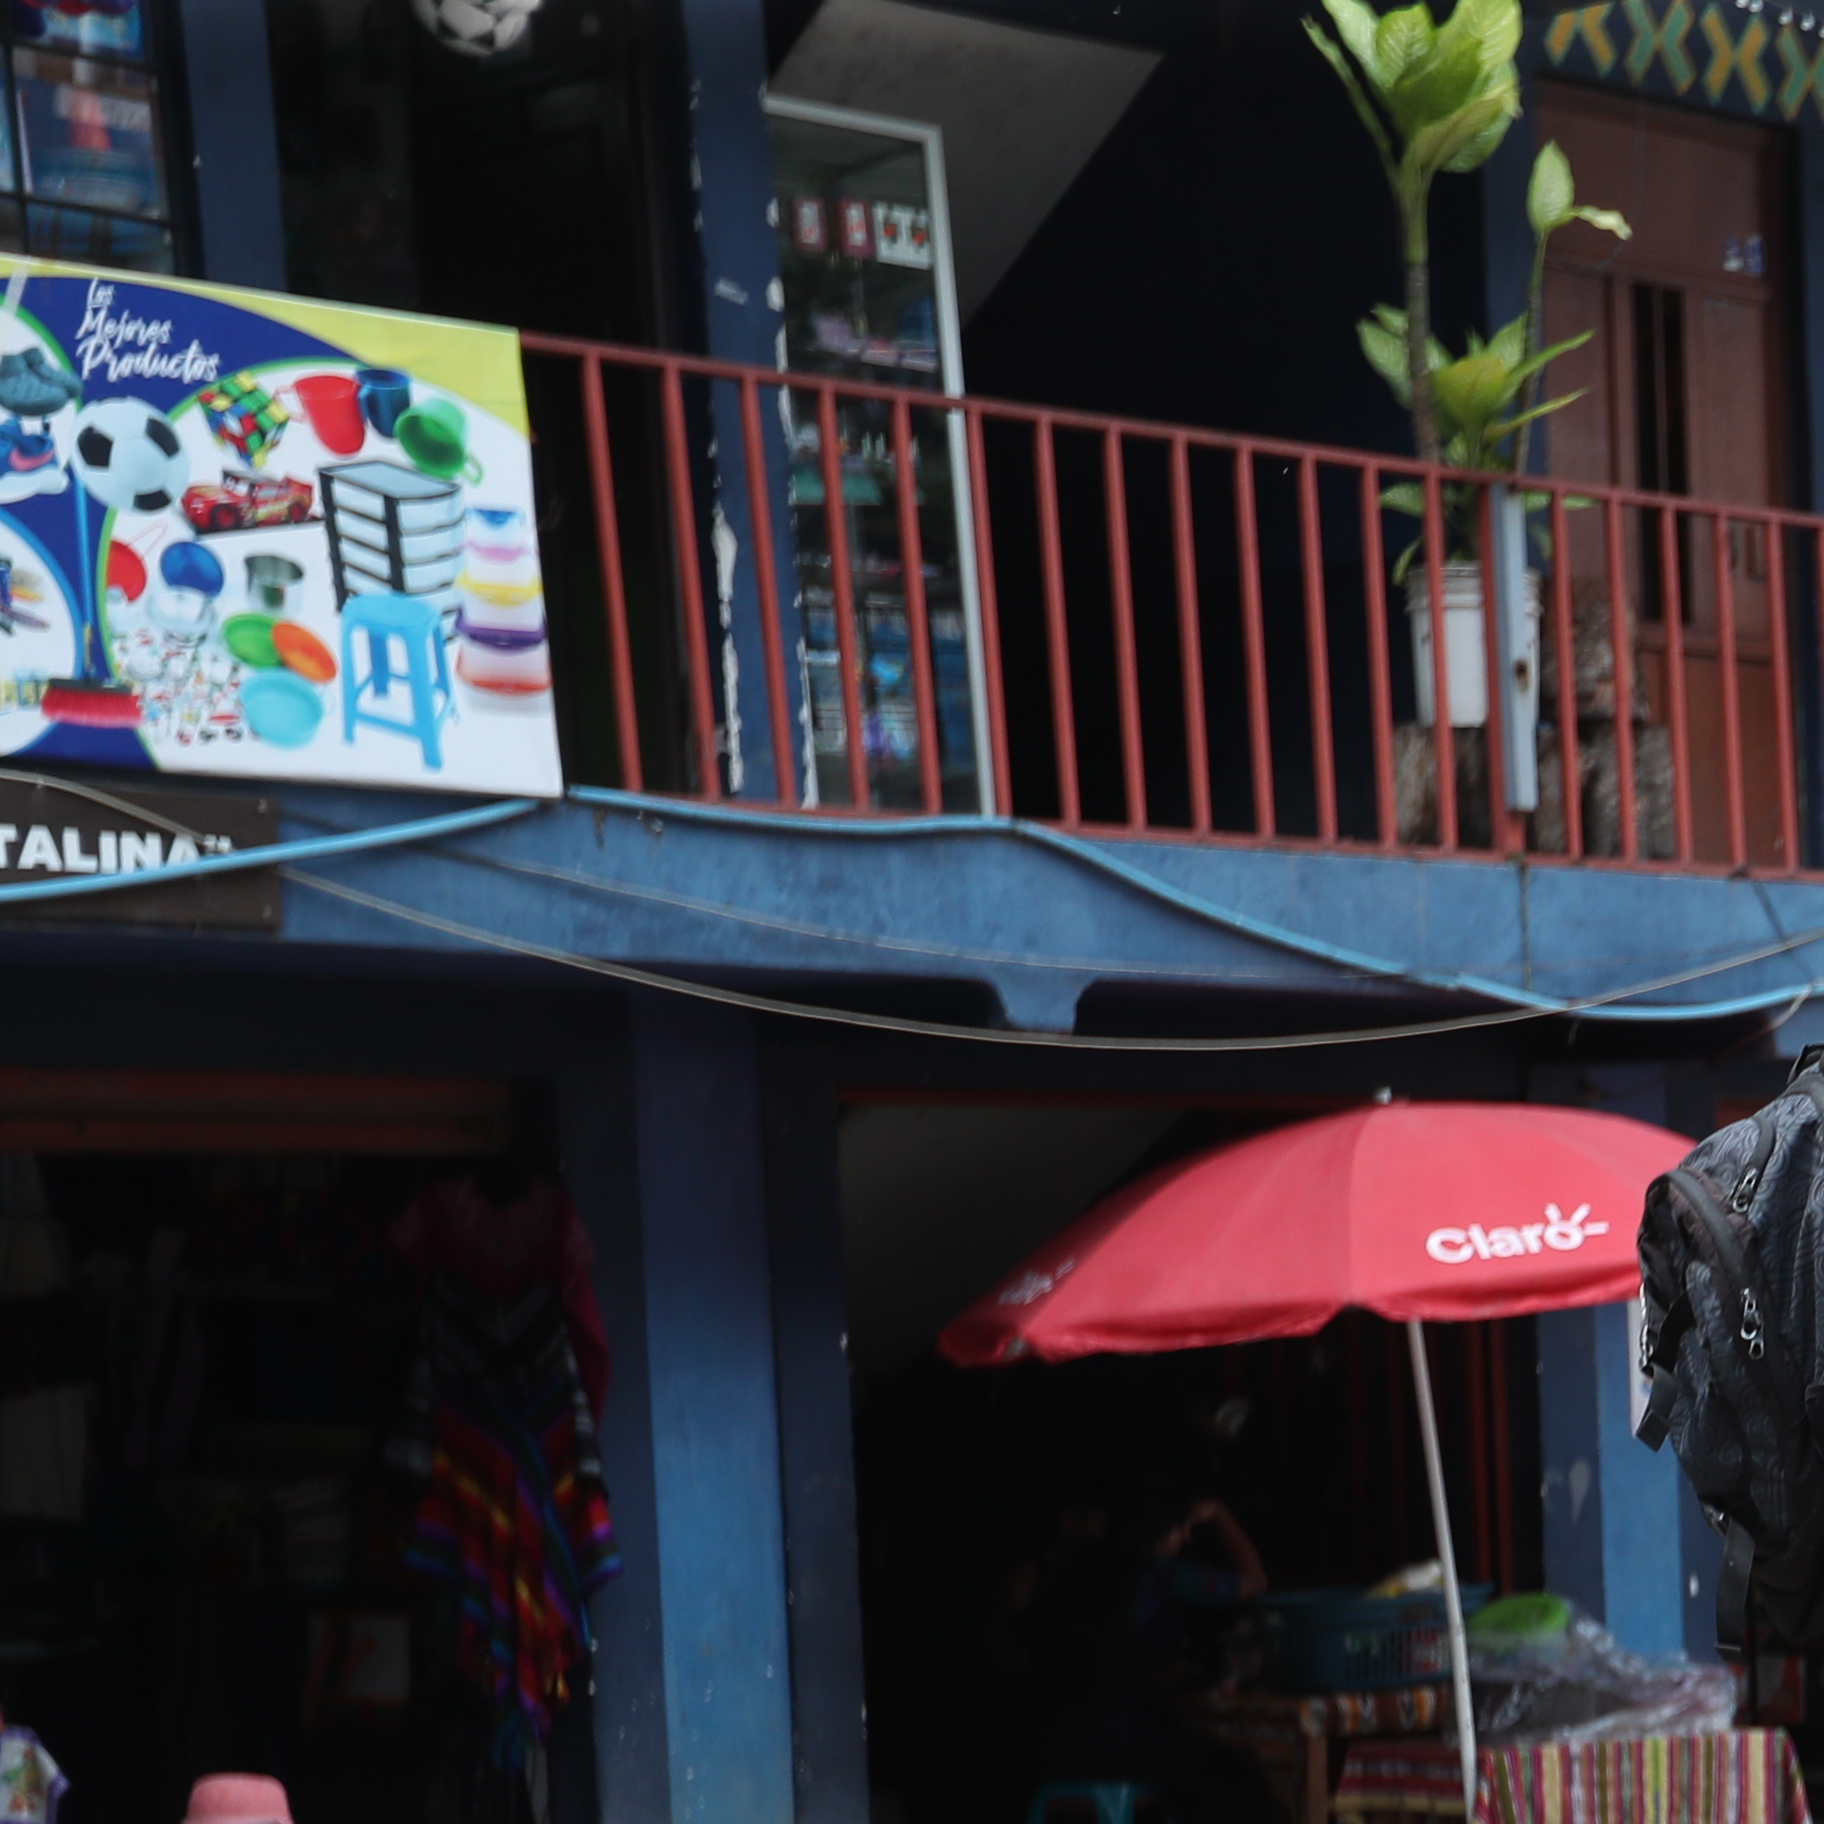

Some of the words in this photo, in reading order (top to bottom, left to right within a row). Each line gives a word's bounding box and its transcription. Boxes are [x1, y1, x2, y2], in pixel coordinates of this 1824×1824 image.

[75, 308, 172, 348] Mejores
[76, 334, 220, 384] Productos
[1426, 1204, 1607, 1264] Claro
